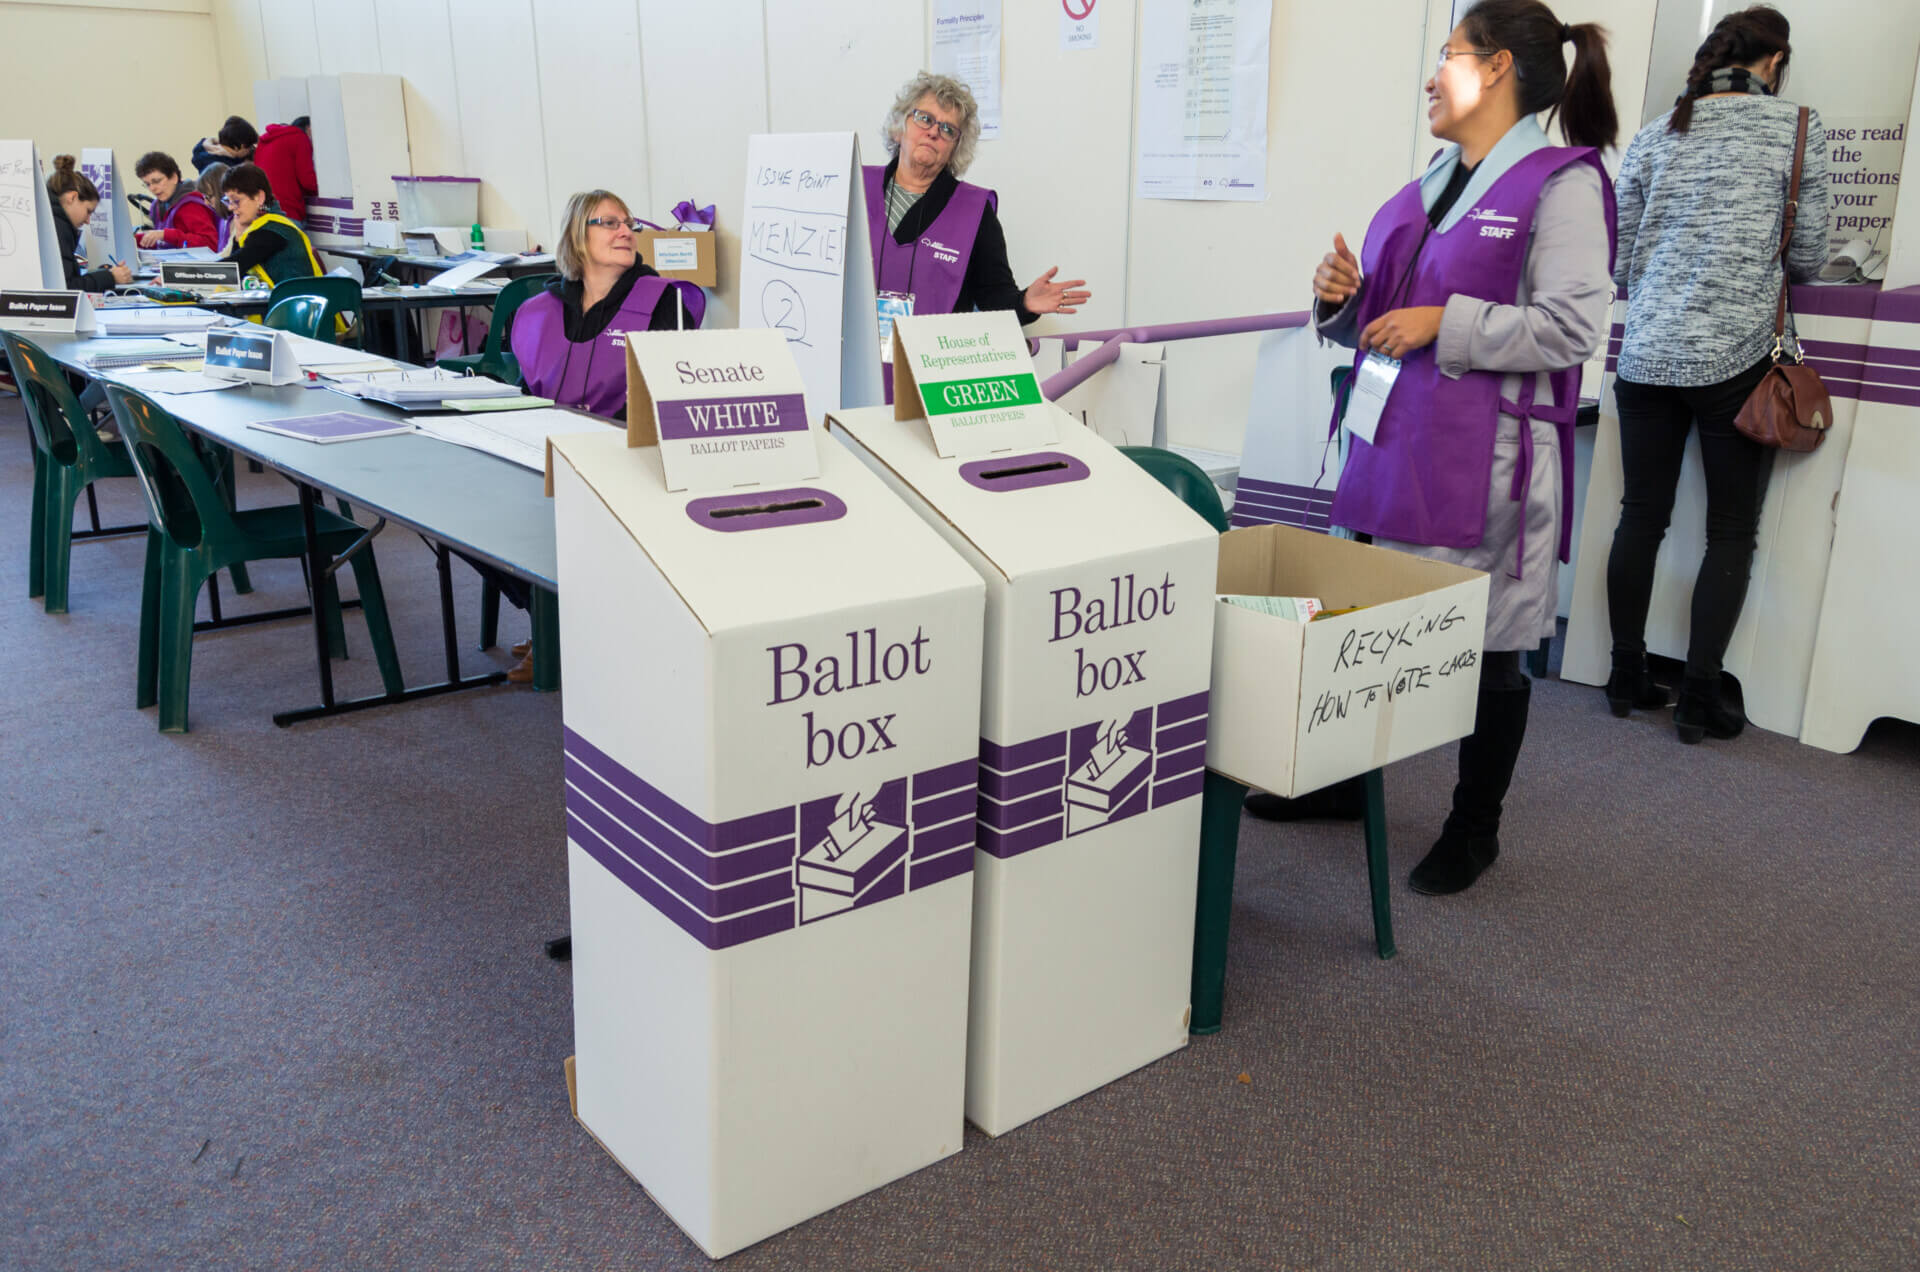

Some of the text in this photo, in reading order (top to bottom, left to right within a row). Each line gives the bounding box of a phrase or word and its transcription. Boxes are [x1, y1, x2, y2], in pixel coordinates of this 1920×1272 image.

[1076, 24, 1085, 32] NO
[1823, 123, 1904, 141] ase read
[1832, 145, 1862, 163] the
[1830, 193, 1878, 210] your
[1480, 225, 1516, 239] STAFF
[1835, 215, 1891, 232] paper
[933, 251, 958, 263] STAFF
[775, 298, 798, 331] 2
[936, 332, 990, 350] House of
[920, 348, 1016, 370] Representatives
[675, 360, 765, 384] Senate
[943, 379, 1020, 407] GREEN
[685, 401, 780, 432] WHITE
[951, 409, 1025, 428] BALLOT PAPERS
[689, 437, 785, 455] BALLOT PAPERS
[1048, 571, 1175, 643] Ballot
[766, 625, 931, 706] Ballot
[1074, 647, 1146, 699] box
[1307, 690, 1351, 734] HOW
[1387, 667, 1432, 702] VOTE
[1439, 649, 1477, 677] CARDS
[802, 711, 897, 769] box
